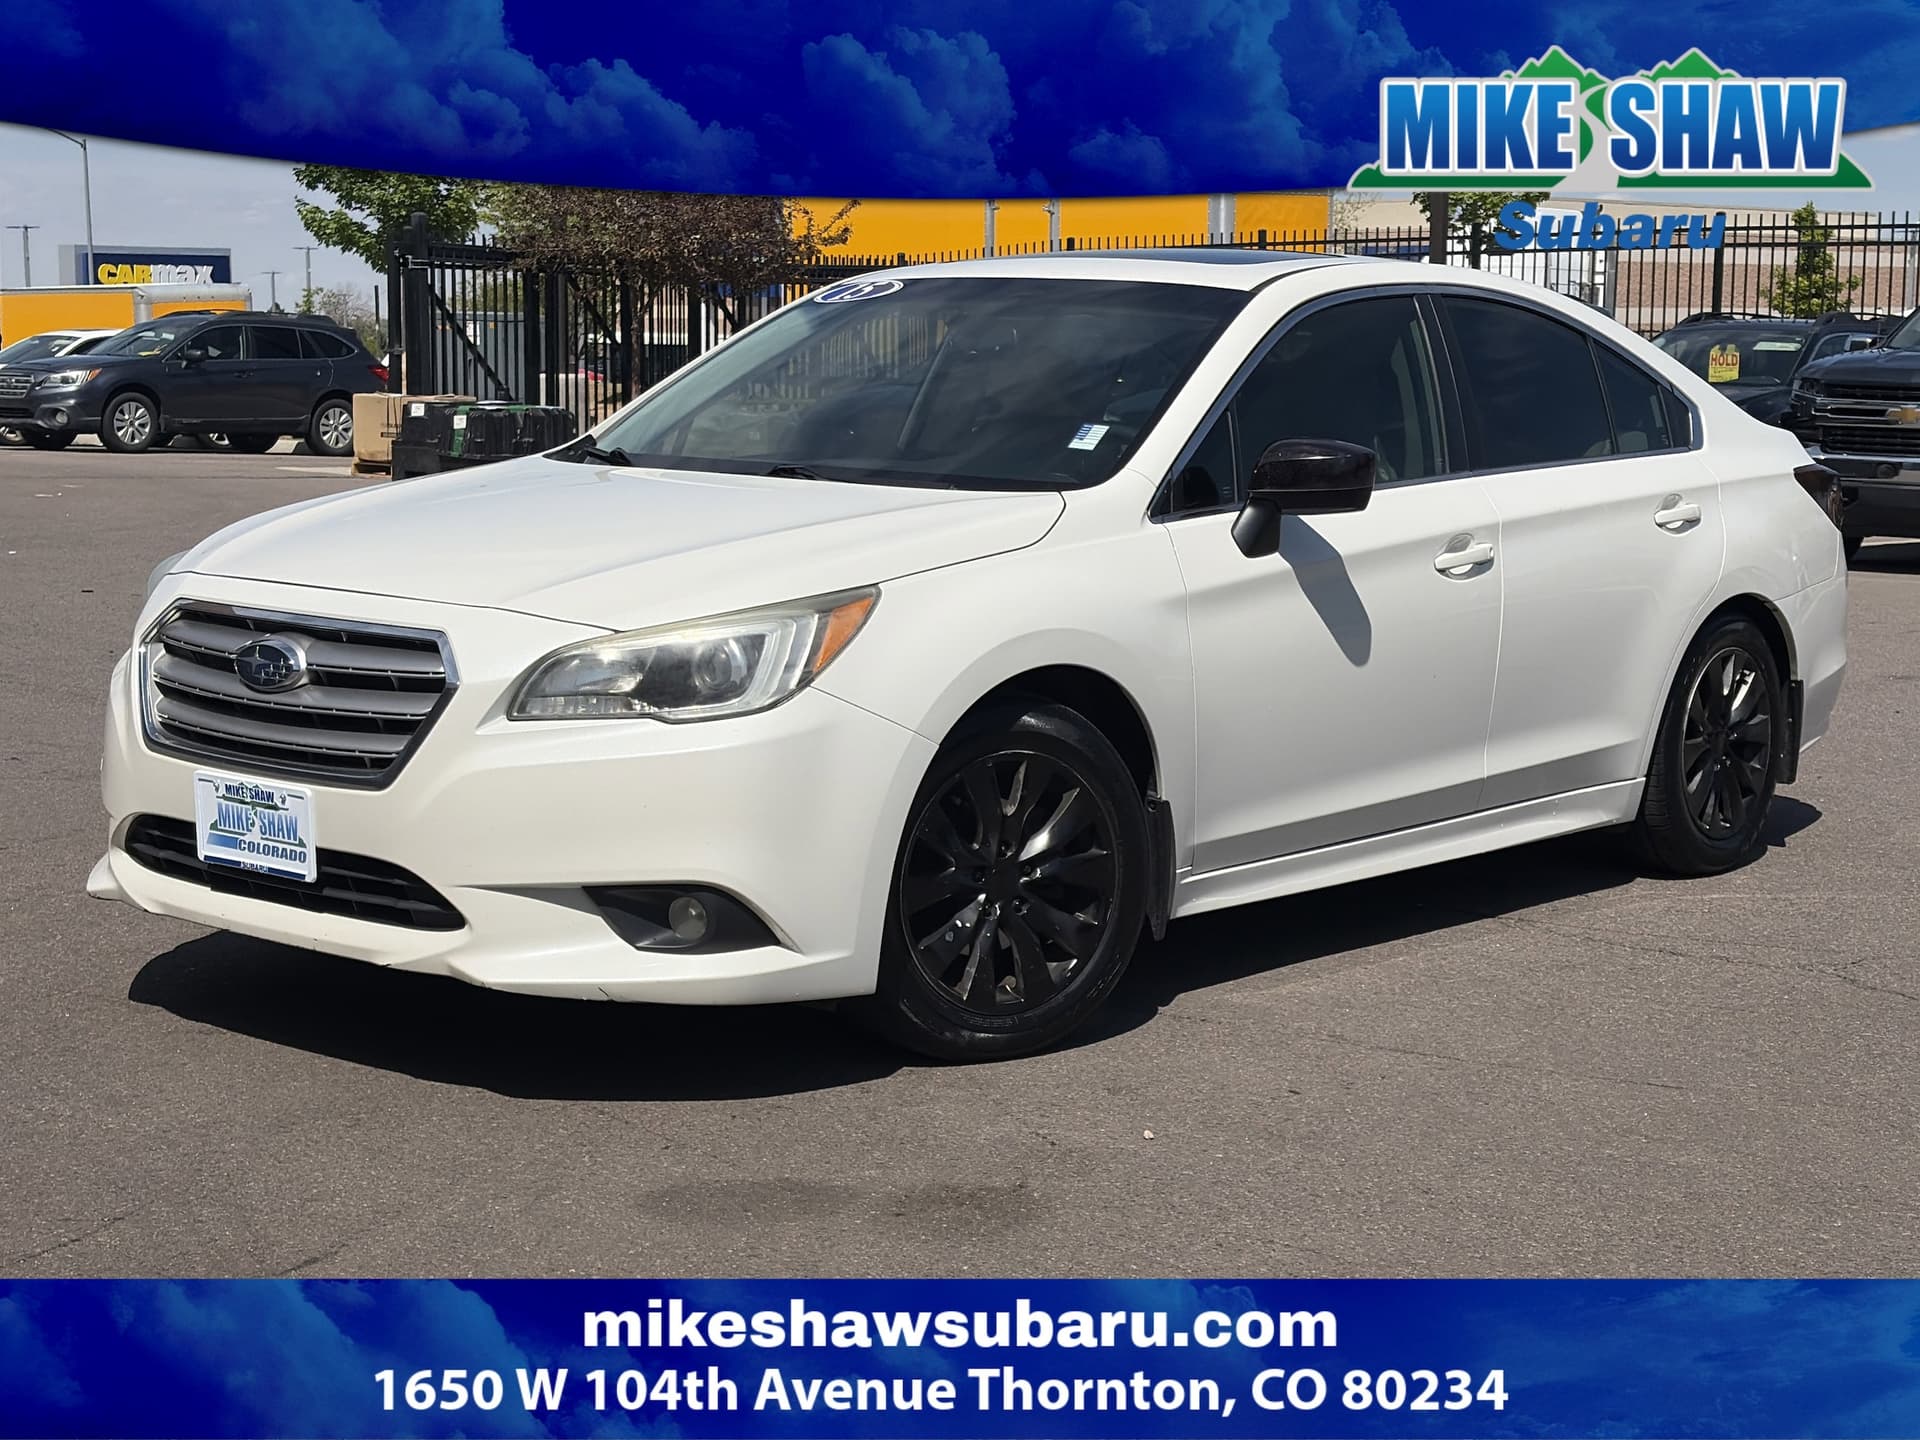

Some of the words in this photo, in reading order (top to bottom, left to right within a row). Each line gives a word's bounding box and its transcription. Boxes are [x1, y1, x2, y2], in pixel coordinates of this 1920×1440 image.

[1711, 353, 1738, 367] HOLD
[225, 783, 247, 798] MIKE
[249, 789, 274, 803] SHAW
[217, 802, 252, 832] MIKE
[259, 810, 298, 841] SHAW
[238, 839, 307, 863] COLORADO
